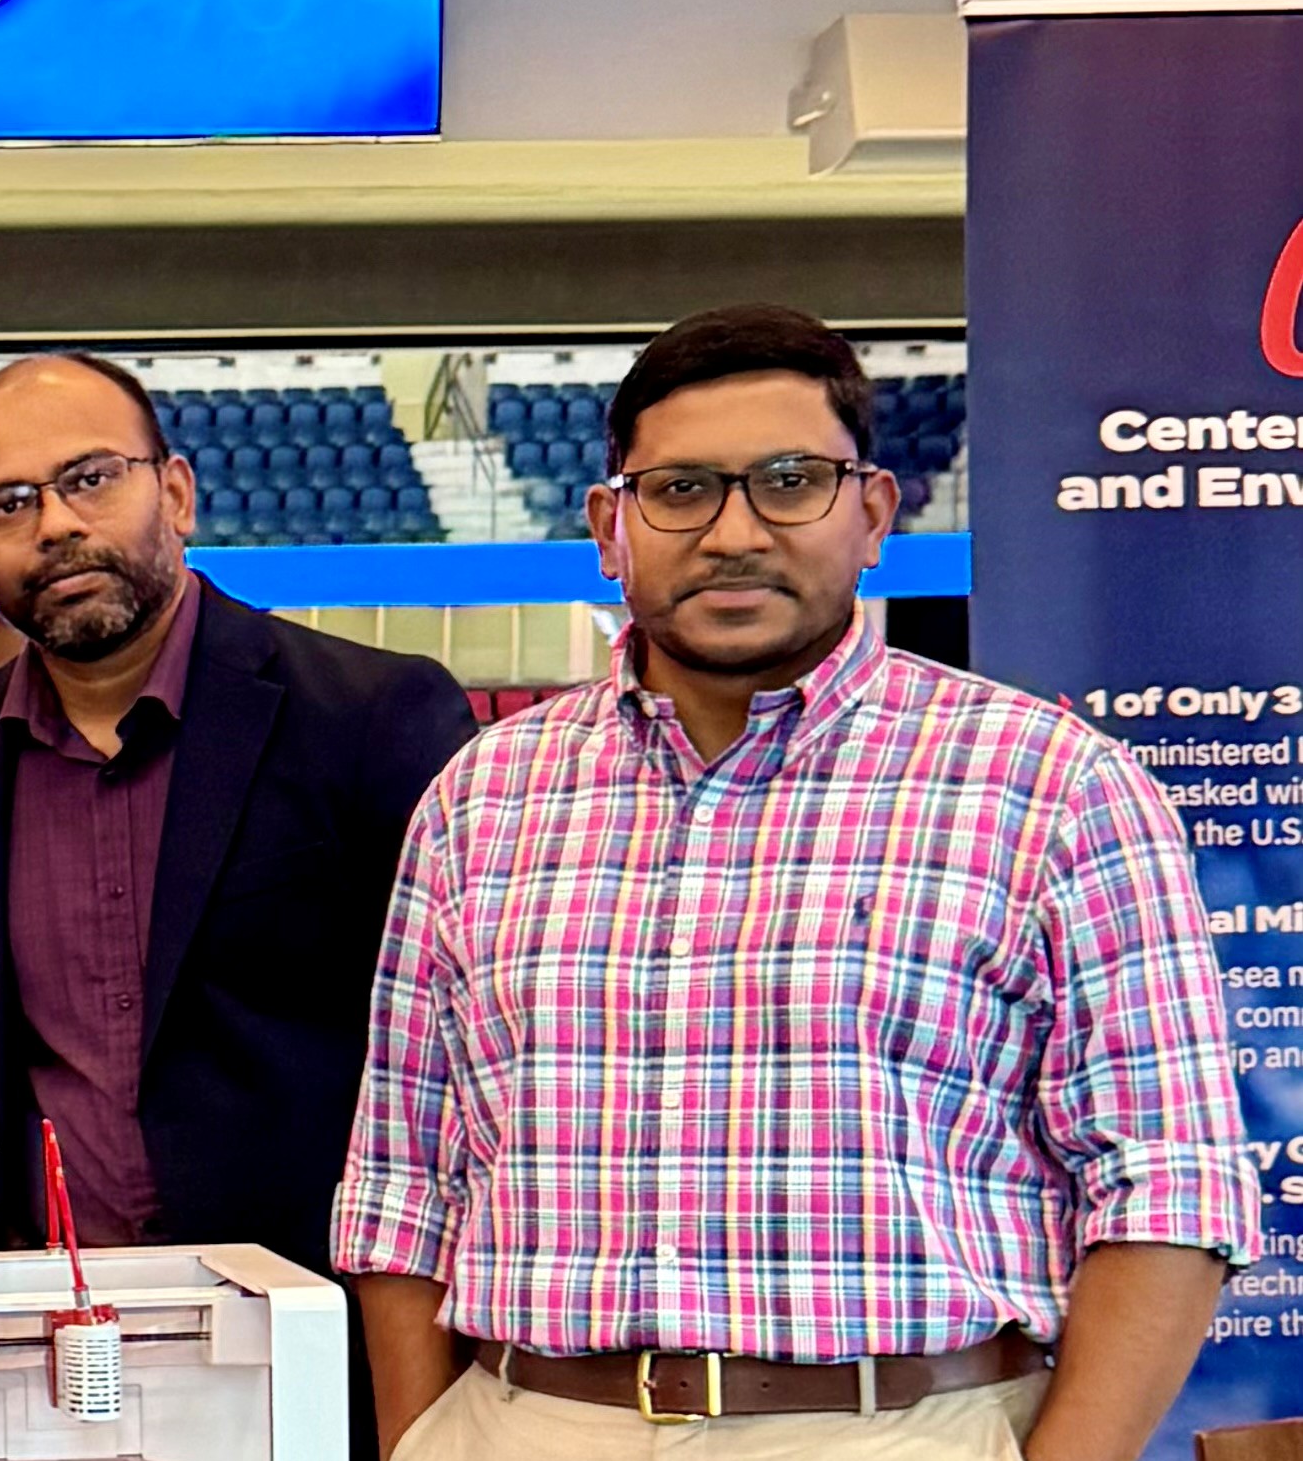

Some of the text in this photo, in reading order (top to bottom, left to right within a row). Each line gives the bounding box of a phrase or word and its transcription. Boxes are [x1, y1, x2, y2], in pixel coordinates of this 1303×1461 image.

[1100, 410, 1303, 452] Cente
[1057, 465, 1303, 511] and Env
[1086, 689, 1107, 717] 1
[1113, 687, 1163, 717] of
[1168, 686, 1268, 721] Only
[1165, 777, 1258, 806] asked
[1194, 818, 1243, 846] the
